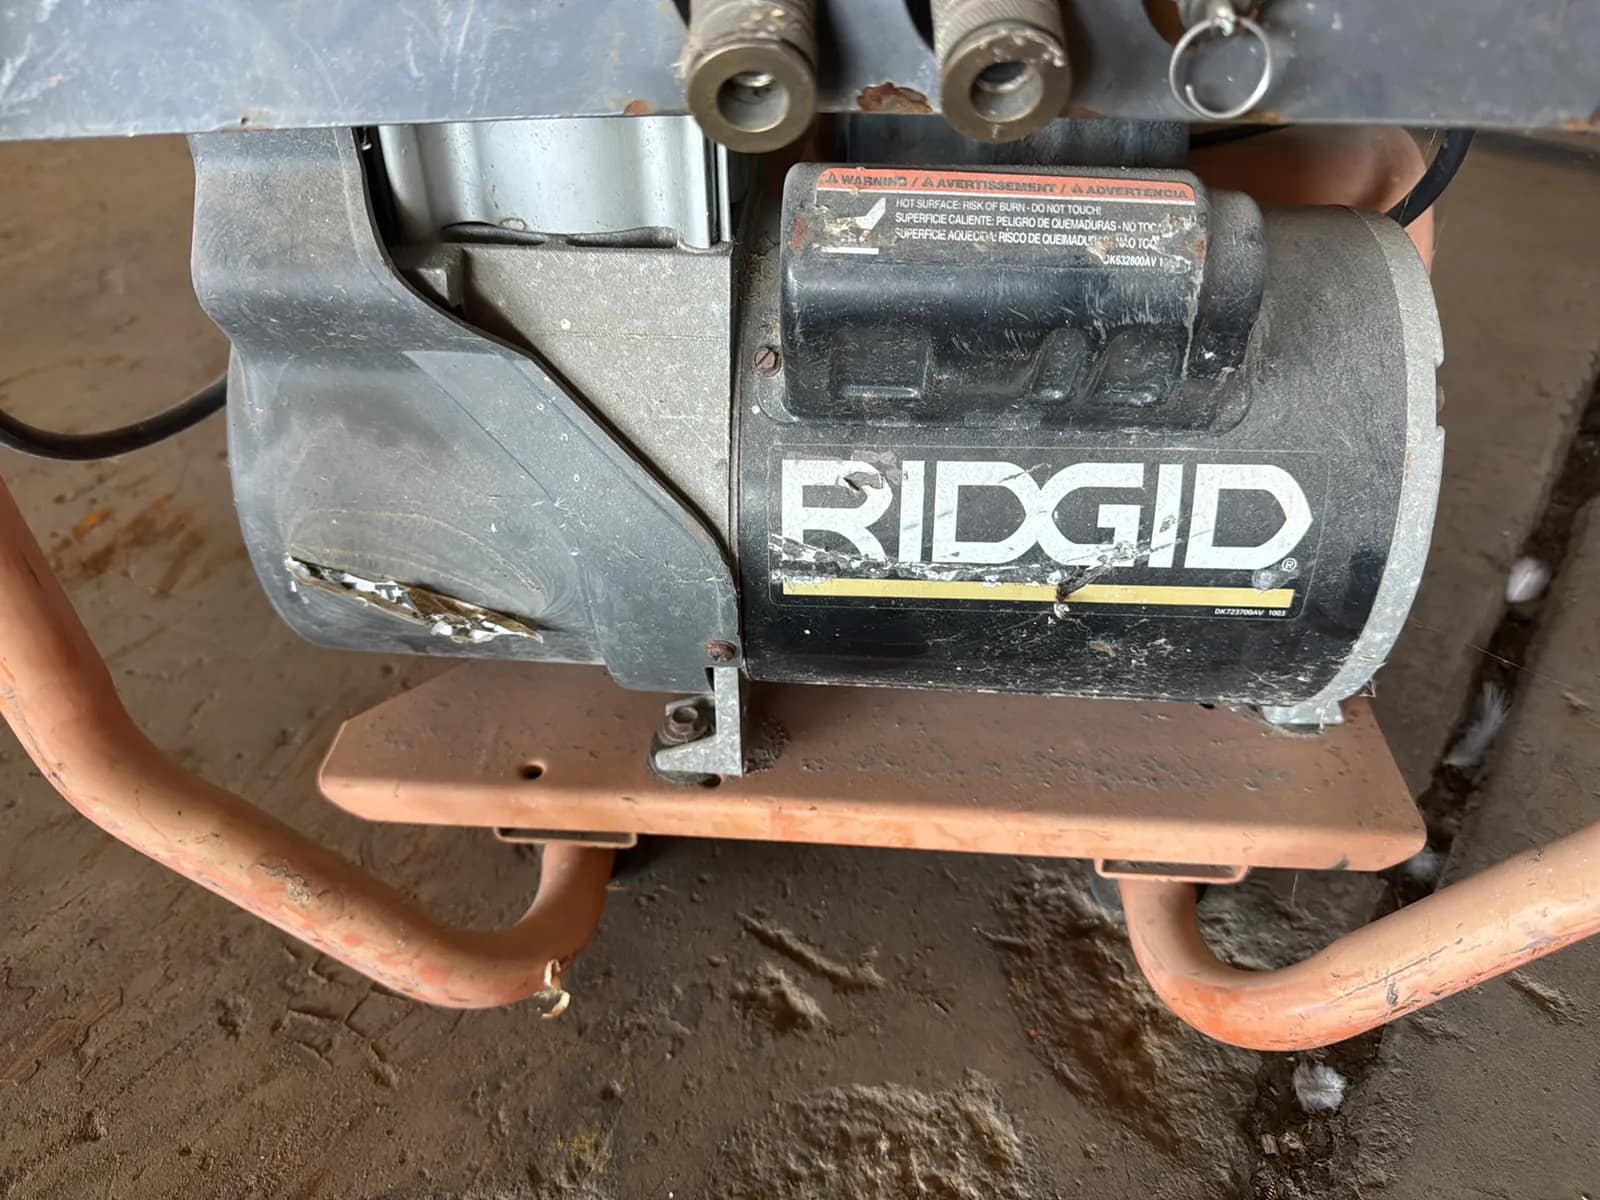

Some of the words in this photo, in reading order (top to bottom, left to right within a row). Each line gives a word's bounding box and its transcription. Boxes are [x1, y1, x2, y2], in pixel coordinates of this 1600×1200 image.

[842, 175, 908, 188] WARNING
[936, 177, 1056, 193] AVERTISSEMENT
[1086, 185, 1188, 199] ADVERTENCIA
[896, 198, 914, 209] HOT
[916, 199, 961, 210] SURFACE:
[963, 201, 984, 211] RISK
[985, 202, 998, 211] OF
[999, 203, 1026, 213] BURN
[1031, 204, 1045, 214] DO
[1046, 204, 1066, 215] NOT
[1067, 205, 1102, 216] TOUCH!
[895, 214, 947, 225] SUPERFICIE
[948, 215, 995, 226] CALIENTE:
[996, 217, 1036, 228] PELIGRO
[1037, 218, 1050, 228] DE
[1051, 219, 1116, 231] QUEMADURAS
[1122, 222, 1137, 232] NO
[895, 228, 947, 240] SUPERFICIE
[1028, 233, 1041, 244] DE
[781, 460, 1314, 571] RIDGID
